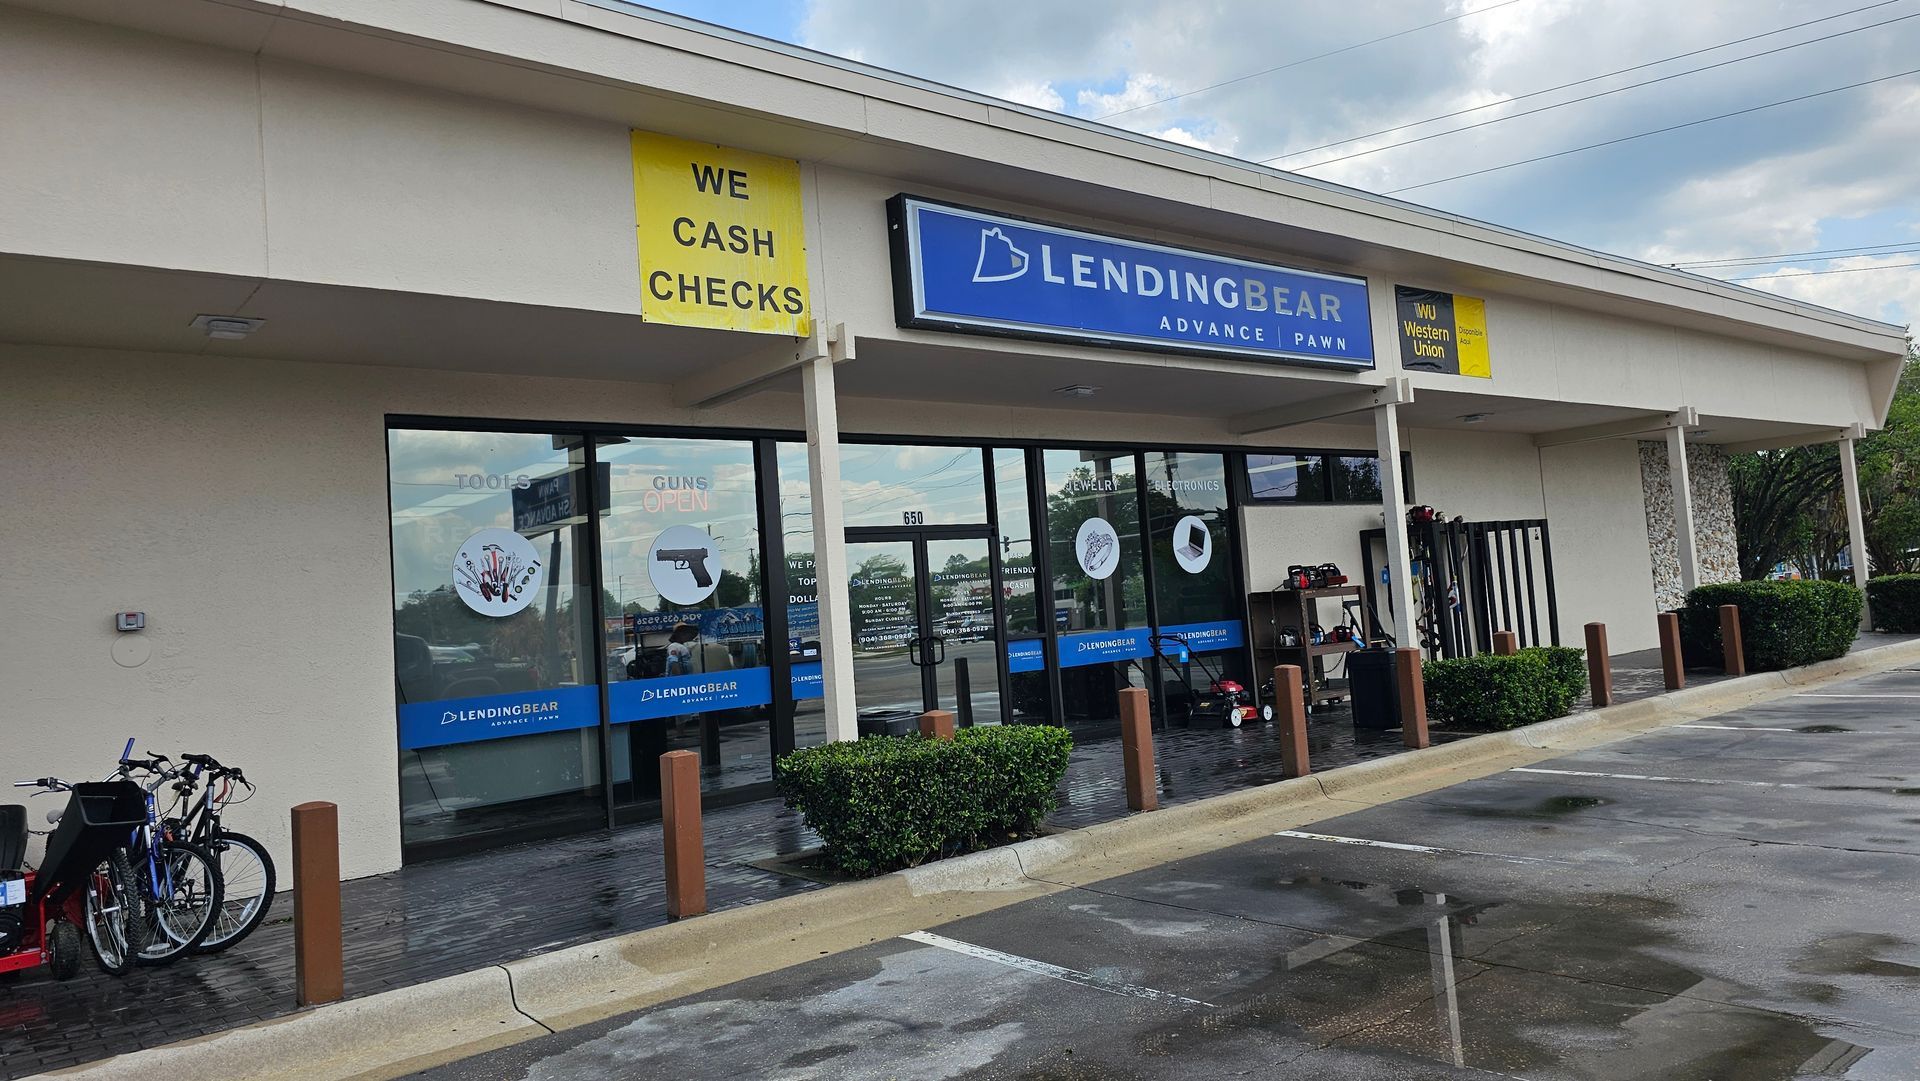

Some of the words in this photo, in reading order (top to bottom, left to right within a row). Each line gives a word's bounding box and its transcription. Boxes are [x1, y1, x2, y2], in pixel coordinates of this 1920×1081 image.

[691, 162, 749, 200] WE
[673, 217, 774, 258] CASH
[1041, 244, 1343, 323] LENDINGBEAR
[649, 270, 804, 315] CHECKS
[1159, 315, 1266, 342] ADVANCE
[1294, 332, 1347, 351] PAWN
[1403, 320, 1450, 341] Western
[1458, 326, 1483, 337] Disponible
[1413, 340, 1445, 358] Union
[454, 473, 531, 490] TOOLS
[653, 475, 708, 490] GUNS
[1065, 480, 1119, 491] JEWELRY
[1154, 480, 1219, 491] ELECTRONICS
[643, 490, 709, 513] OPEN
[904, 511, 924, 525] 650
[788, 560, 803, 569] WE
[1001, 566, 1036, 574] FRIENDLY
[798, 577, 817, 586] TOP
[1183, 629, 1227, 640] LENDINGBEAR
[1086, 638, 1136, 650] LENDINGBEAR
[656, 682, 737, 699] LENDINGBEAR
[681, 696, 713, 704] ADVANCE
[459, 701, 559, 722] LENDINGBEAR
[491, 718, 528, 727] ADVANCE
